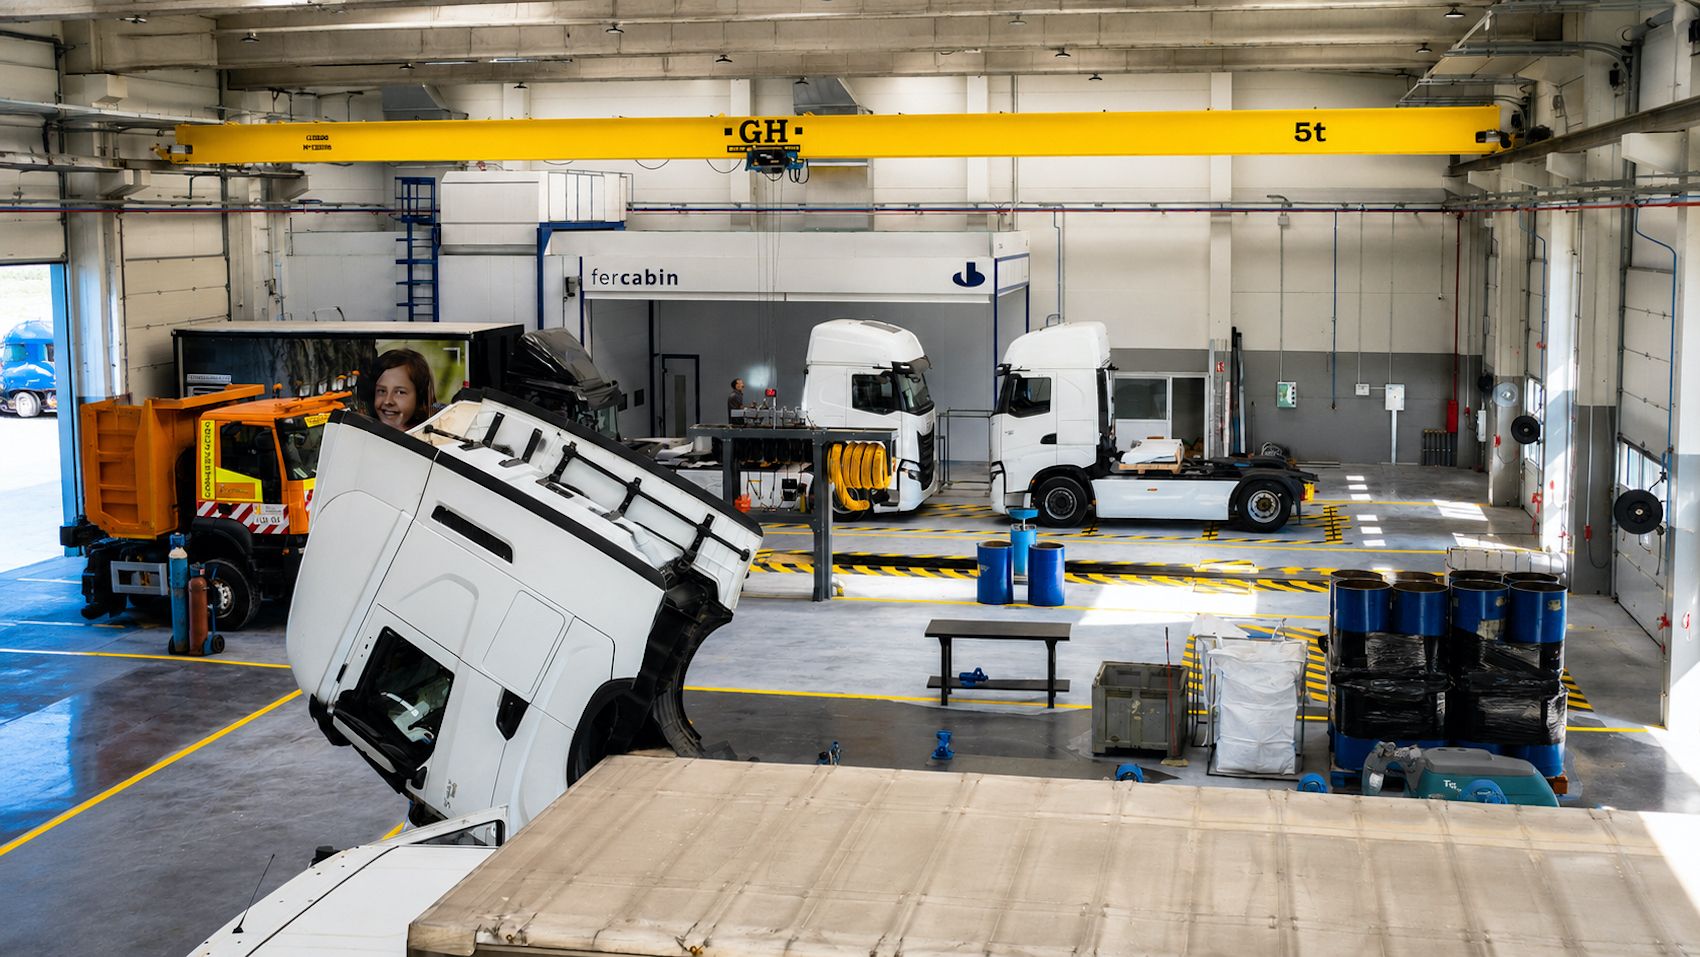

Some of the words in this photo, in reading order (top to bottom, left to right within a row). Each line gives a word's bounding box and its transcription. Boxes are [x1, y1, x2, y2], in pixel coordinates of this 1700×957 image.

[739, 119, 788, 143] GH
[1294, 121, 1326, 142] 5t
[591, 268, 678, 285] fercabin
